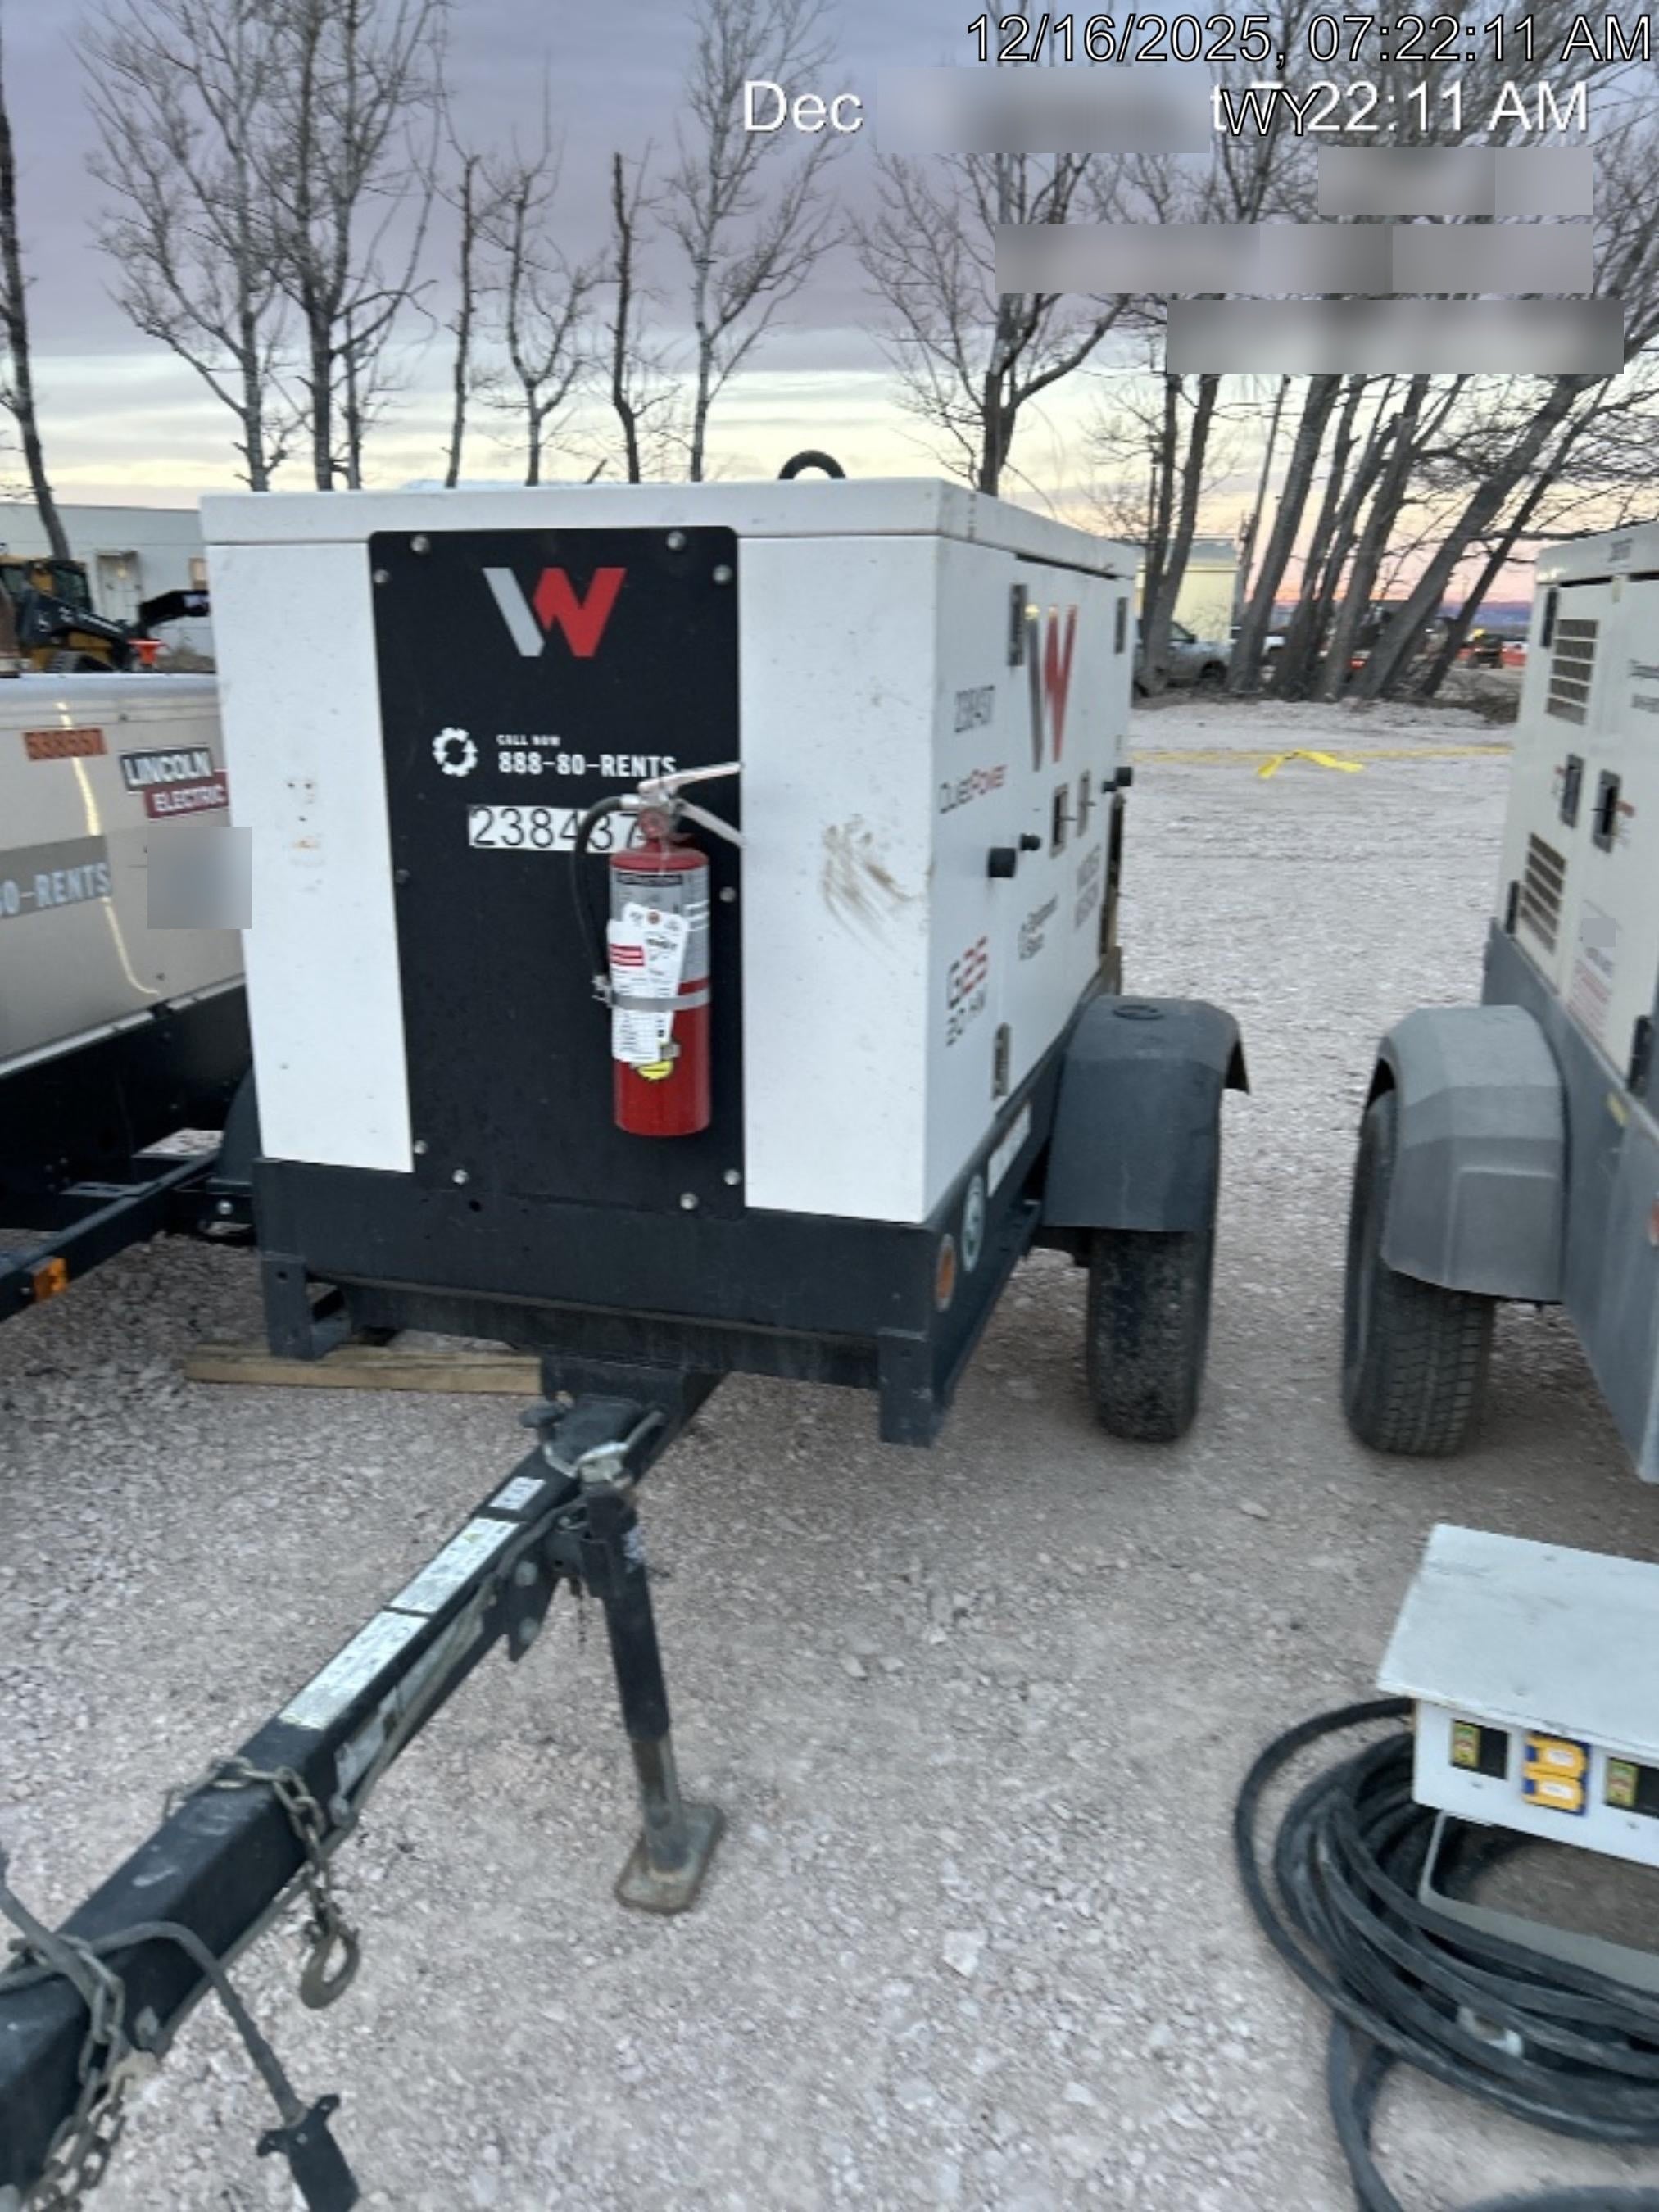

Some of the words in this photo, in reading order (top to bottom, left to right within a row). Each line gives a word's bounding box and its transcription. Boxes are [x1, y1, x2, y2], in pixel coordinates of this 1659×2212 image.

[496, 734, 529, 746] CALL
[123, 751, 213, 785] LINCOLN
[498, 751, 678, 777] 888-80-RENTS
[153, 784, 226, 812] ELECTRIC
[0, 862, 111, 916] 0-RENTS
